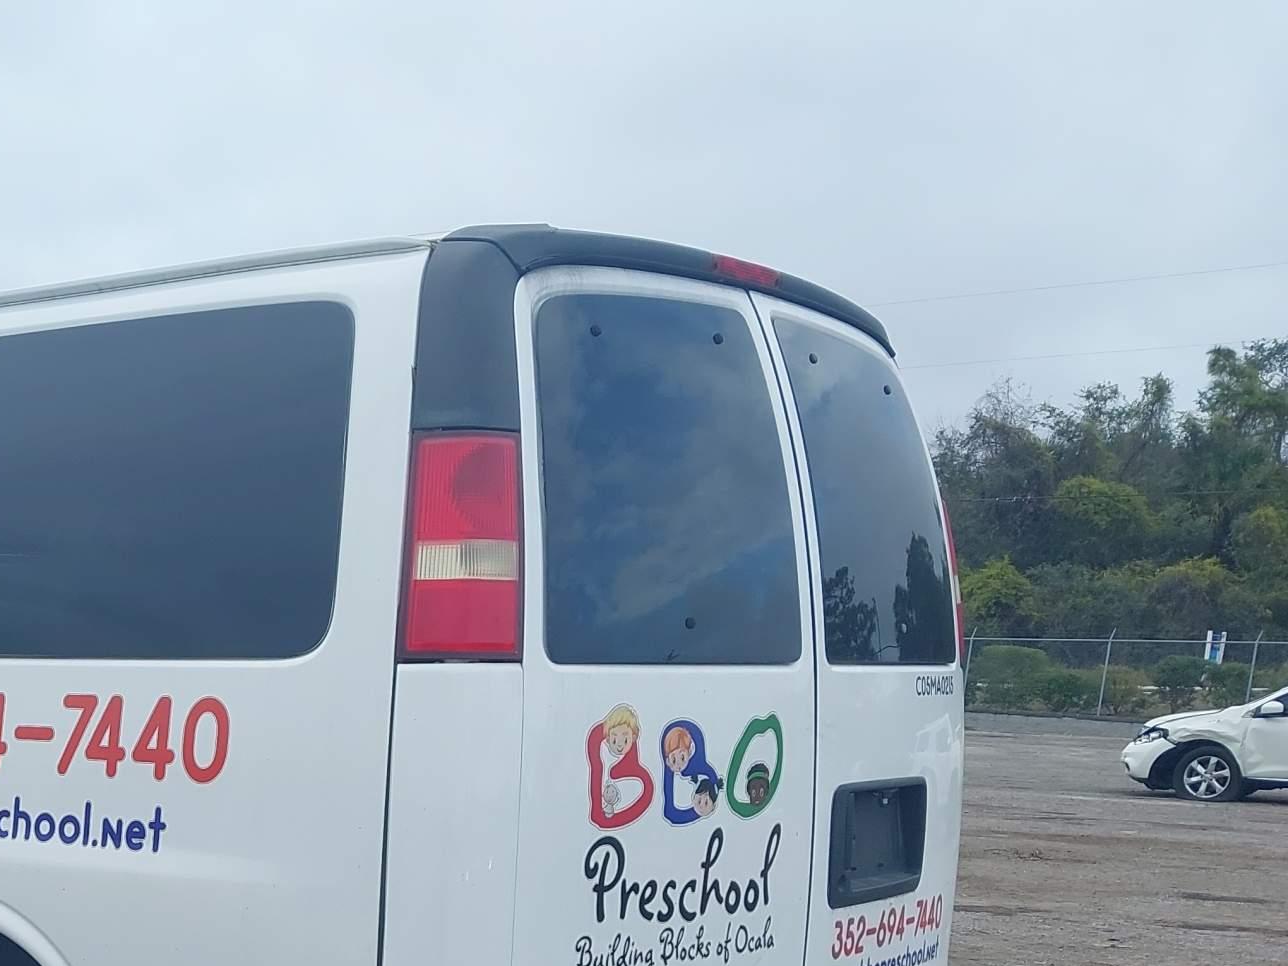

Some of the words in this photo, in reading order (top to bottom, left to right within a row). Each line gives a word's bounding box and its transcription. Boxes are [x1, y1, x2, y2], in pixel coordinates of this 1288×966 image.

[584, 824, 782, 922] Preschool
[715, 922, 733, 963] of
[734, 915, 775, 950] Ocala
[832, 894, 943, 960] 352-694-7440
